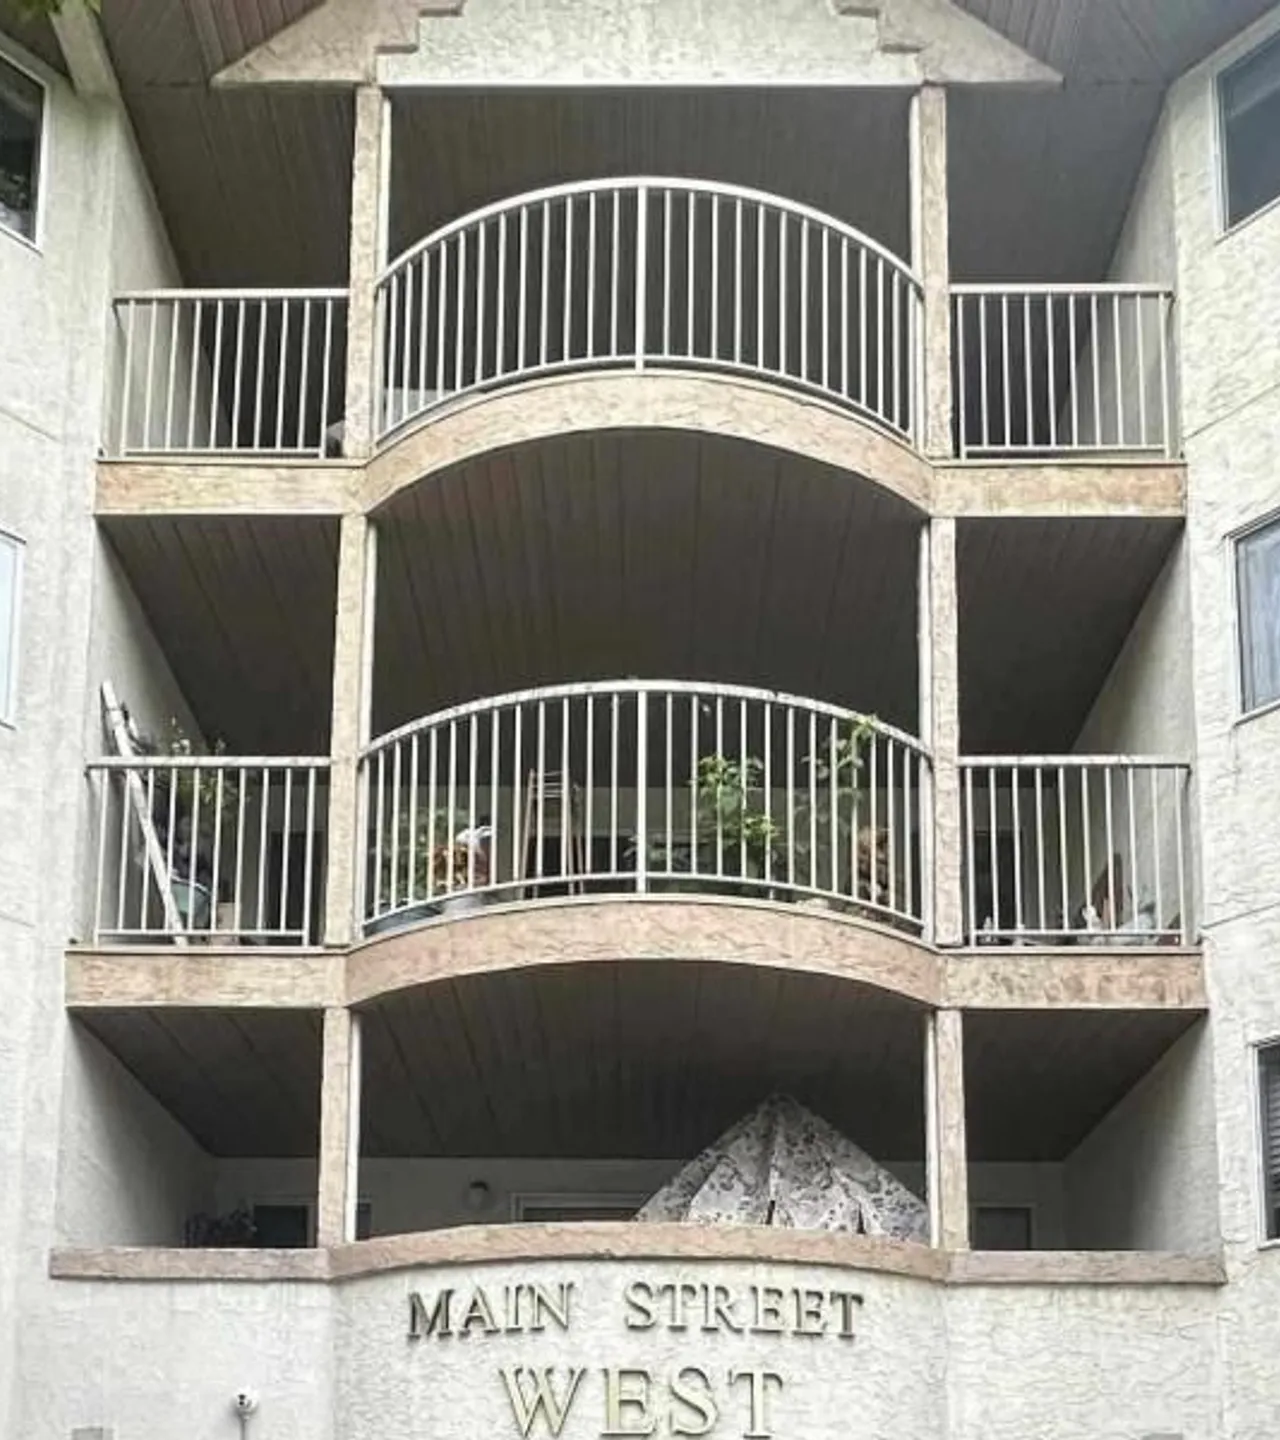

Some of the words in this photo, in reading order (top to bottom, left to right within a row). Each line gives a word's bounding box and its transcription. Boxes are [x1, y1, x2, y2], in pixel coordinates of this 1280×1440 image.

[406, 1281, 574, 1340] MAIN
[624, 1282, 865, 1338] STREET
[499, 1367, 785, 1440] WEST
